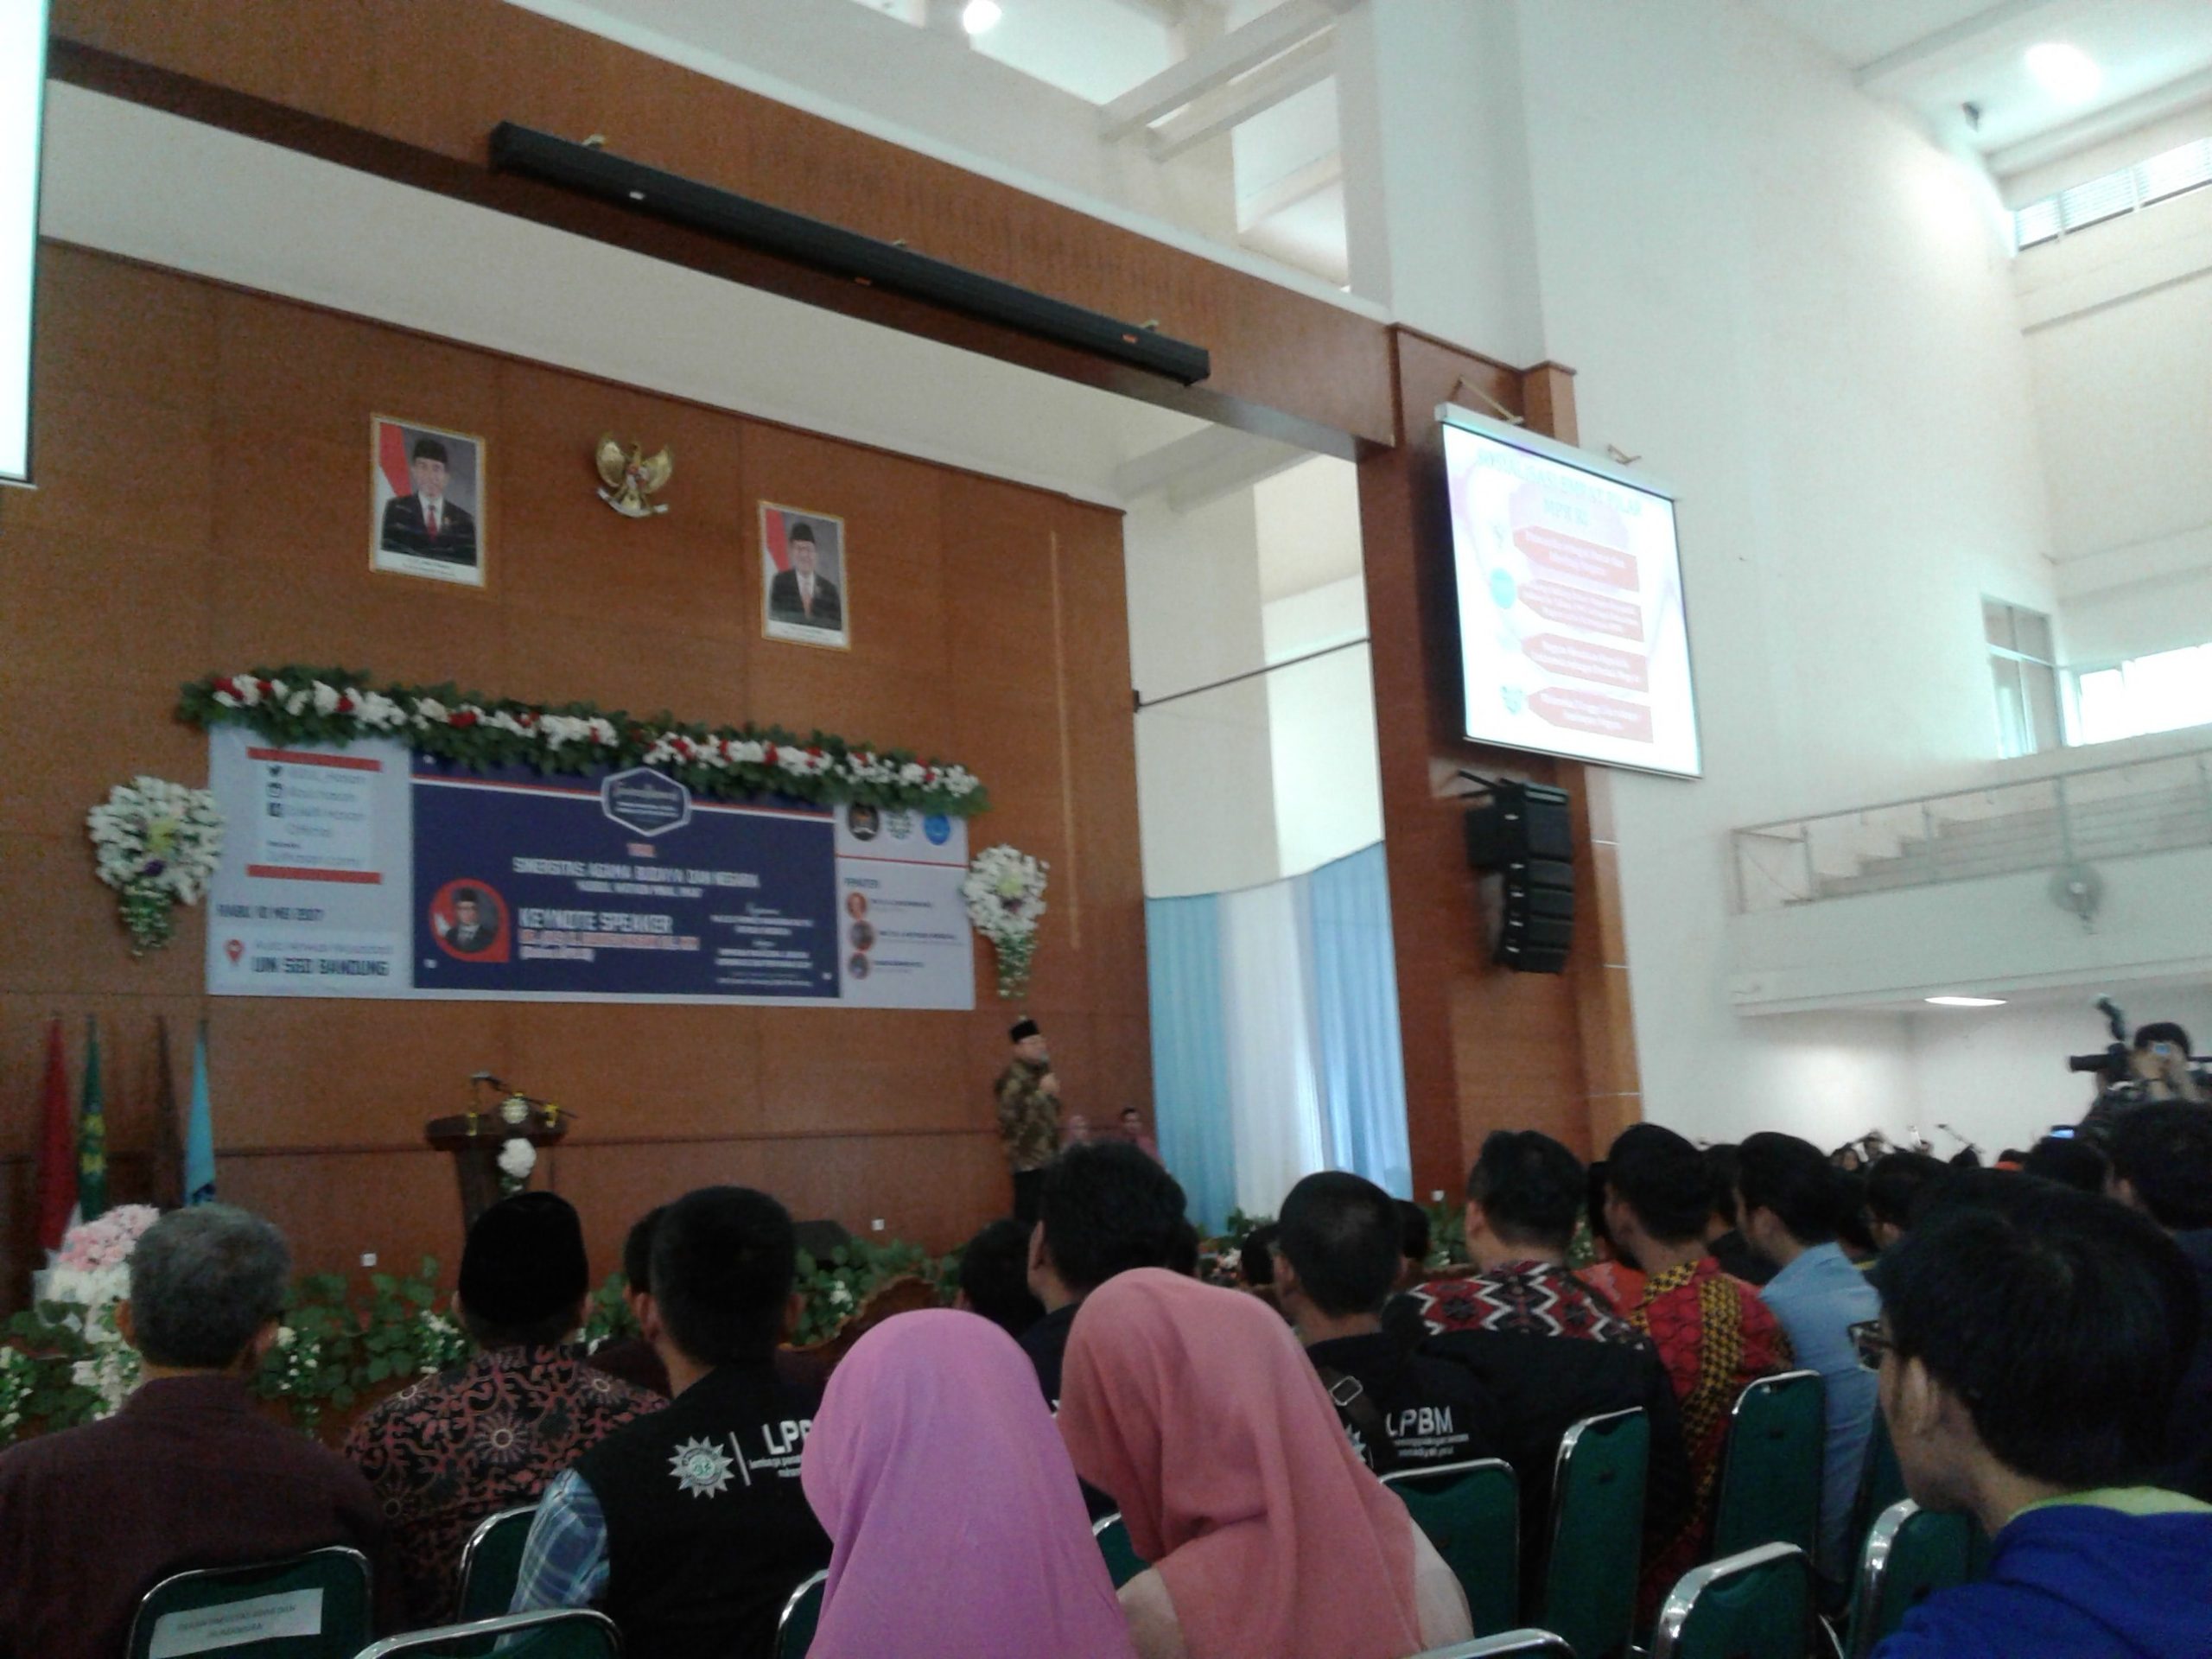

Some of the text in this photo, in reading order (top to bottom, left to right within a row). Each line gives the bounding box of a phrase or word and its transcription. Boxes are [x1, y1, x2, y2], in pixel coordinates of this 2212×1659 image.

[518, 907, 673, 934] KEYNOTE SPEAKER
[1385, 1405, 1453, 1436] LPBM
